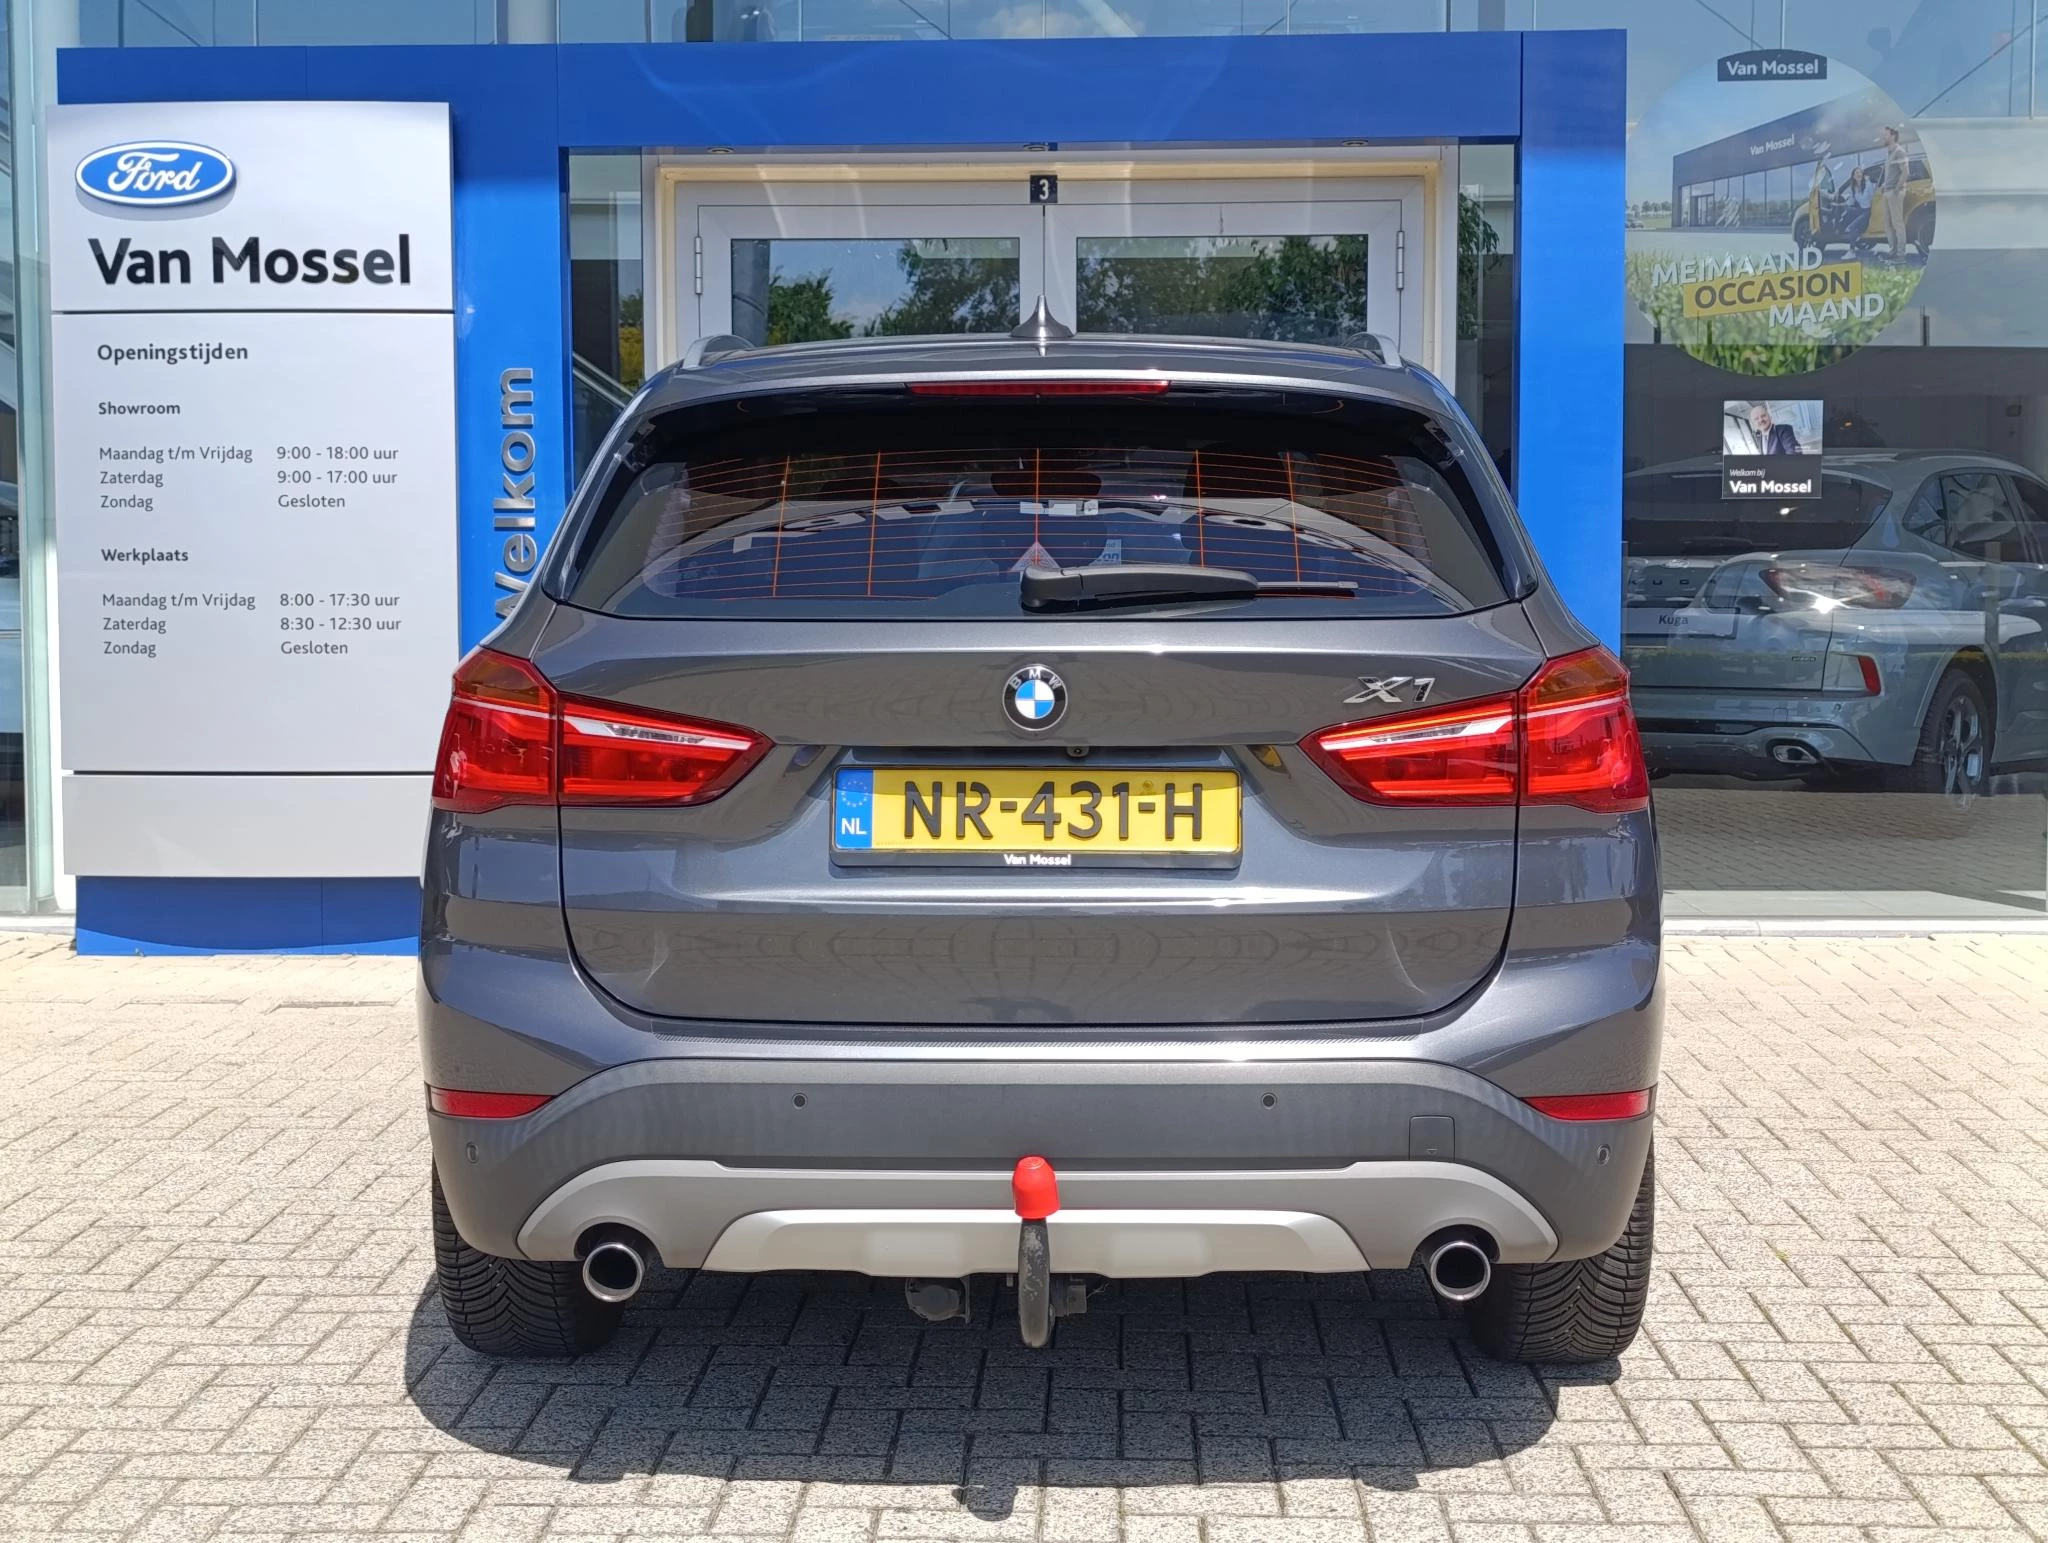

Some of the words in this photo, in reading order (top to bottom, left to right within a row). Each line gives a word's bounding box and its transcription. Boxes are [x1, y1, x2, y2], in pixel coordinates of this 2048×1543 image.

[1726, 60, 1757, 76] Van
[1761, 58, 1819, 76] Mossel
[1750, 142, 1764, 156] Van
[1765, 134, 1795, 153] Mossel
[107, 152, 203, 192] Ford
[1039, 179, 1049, 200] 3
[88, 237, 191, 285] Van
[212, 234, 411, 285] Mossel
[1694, 270, 1851, 309] OCCASION
[1768, 293, 1885, 328] MAAND
[97, 342, 248, 366] Openingstijden
[98, 401, 181, 415] Showroom
[99, 446, 164, 465] Maandag
[168, 445, 195, 461] t/m
[200, 446, 253, 465] Vrijdag
[276, 446, 311, 460] 9:00
[326, 446, 369, 460] 18:00
[373, 449, 399, 460] uur
[99, 470, 164, 489] Zaterdag
[277, 470, 312, 484] 9:00
[326, 470, 368, 484] 17:00
[372, 474, 398, 484] uur
[1729, 468, 1757, 478] Welkom
[1729, 480, 1757, 494] Van
[1761, 479, 1812, 494] Mossel
[100, 494, 154, 512] Zondag
[277, 494, 346, 508] Gesloten
[101, 547, 189, 566] Werkplaats
[102, 593, 168, 611] Maandag
[171, 592, 198, 607] t/m
[202, 593, 256, 611] Vrijdag
[279, 593, 315, 607] 8:00
[330, 593, 370, 607] 17:30
[374, 596, 400, 607] uur
[103, 617, 167, 635] Zaterdag
[280, 617, 315, 631] 8:30
[330, 617, 372, 631] 12:30
[376, 620, 401, 631] uur
[103, 641, 157, 659] Zondag
[280, 641, 348, 655] Gesloten
[1009, 667, 1063, 690] BMW
[1342, 676, 1436, 704] X1
[904, 780, 1203, 840] NR-431-H
[841, 817, 867, 835] NL
[1003, 853, 1027, 865] Van
[1029, 853, 1071, 866] Mossel
